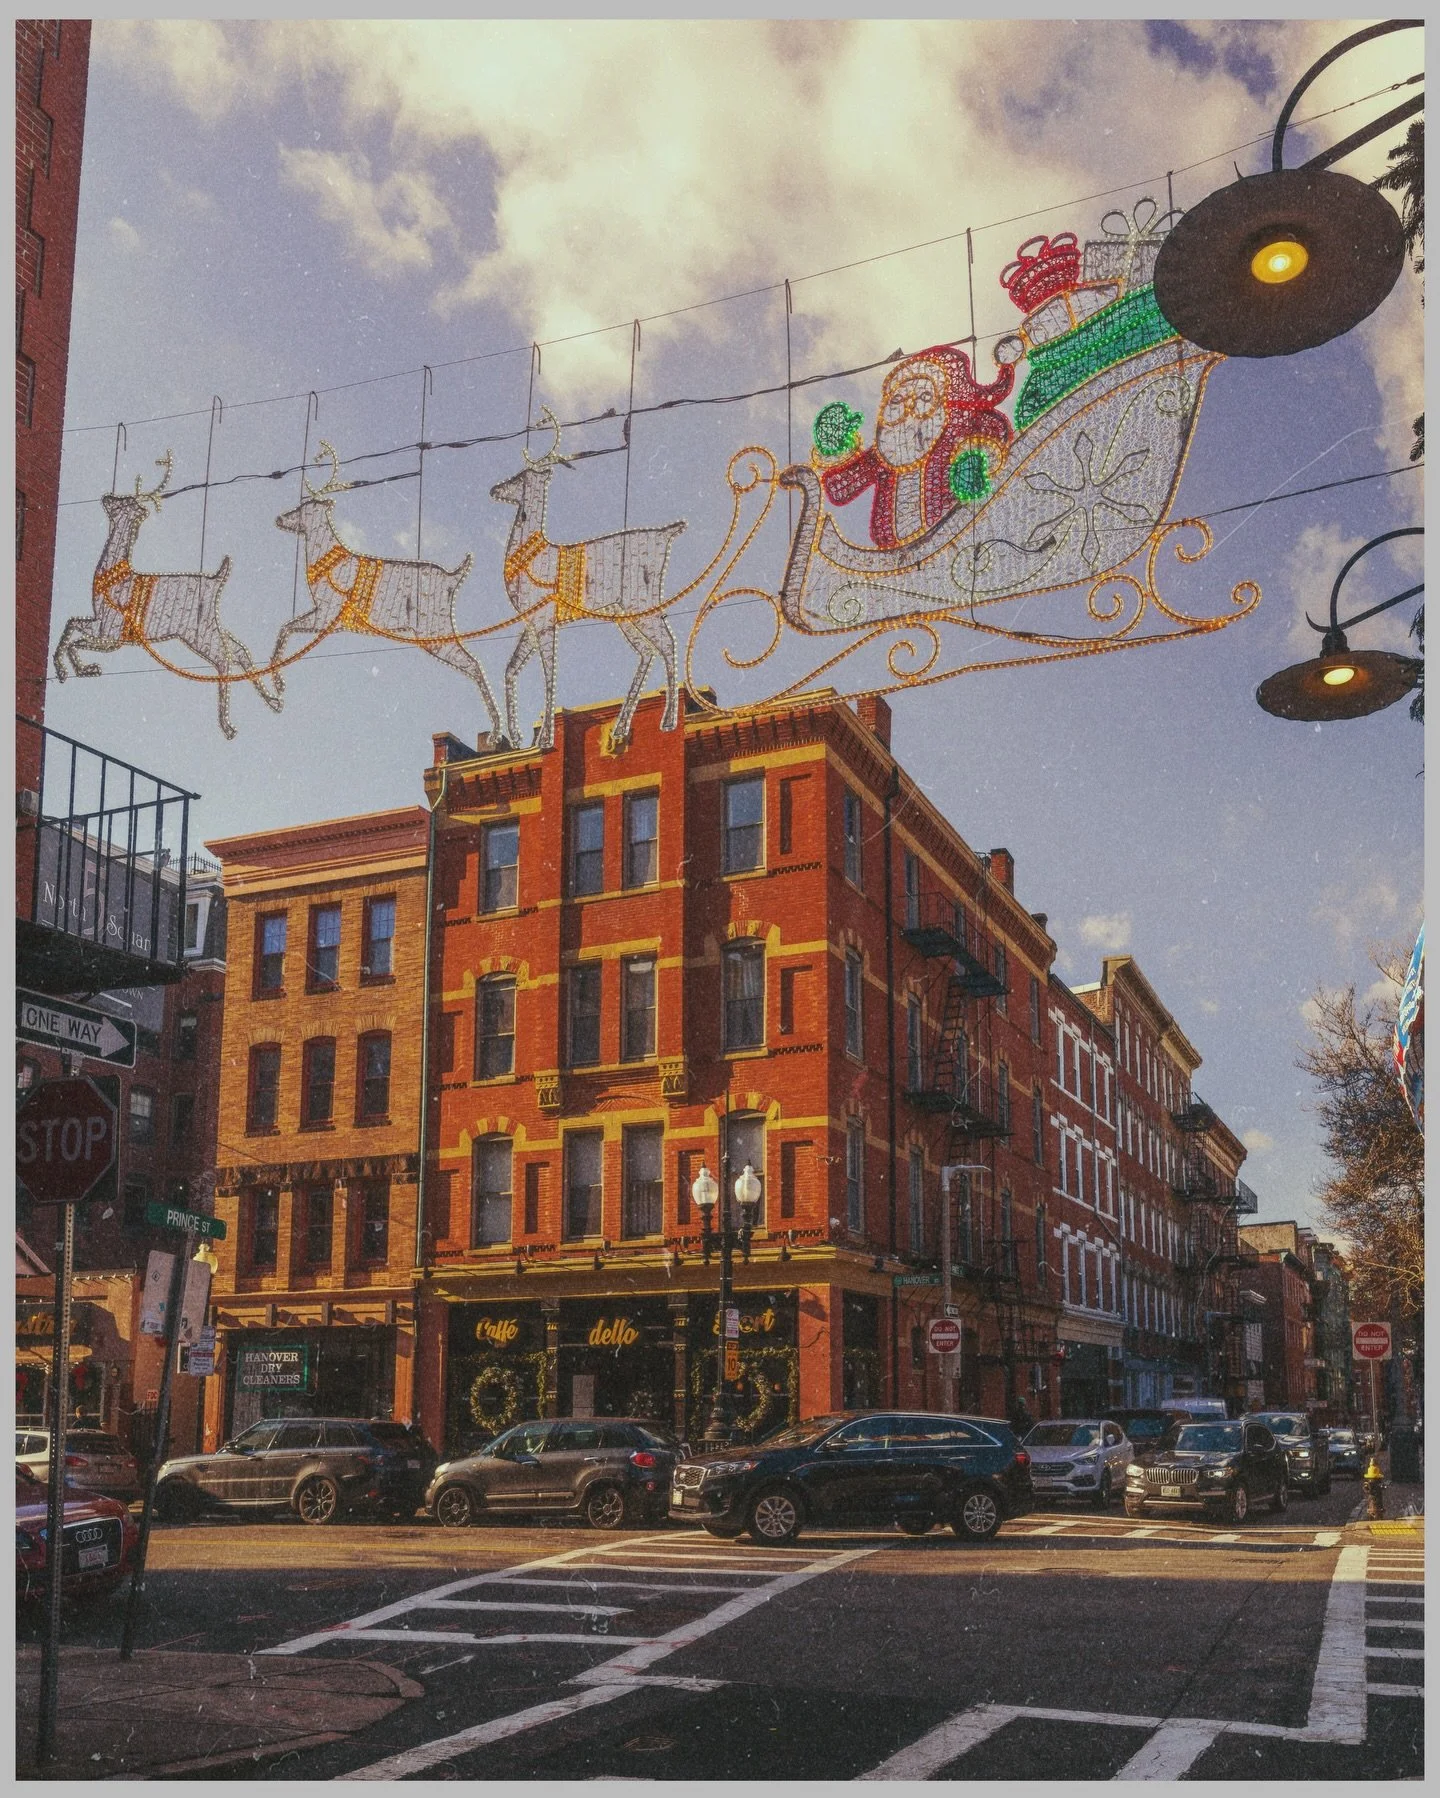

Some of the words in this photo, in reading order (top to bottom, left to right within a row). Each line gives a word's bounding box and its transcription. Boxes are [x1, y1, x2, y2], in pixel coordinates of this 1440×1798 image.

[26, 1007, 60, 1033] ONE
[68, 1018, 102, 1044] WAY
[17, 1116, 107, 1164] STOP
[166, 1209, 200, 1231] PRINCE
[201, 1221, 211, 1233] ST
[903, 1275, 930, 1285] HANOVER
[475, 1318, 519, 1345] Caffé
[588, 1317, 639, 1346] dello
[245, 1352, 299, 1362] HANOVER
[261, 1363, 282, 1373] DRY
[243, 1374, 301, 1385] CLEANERS
